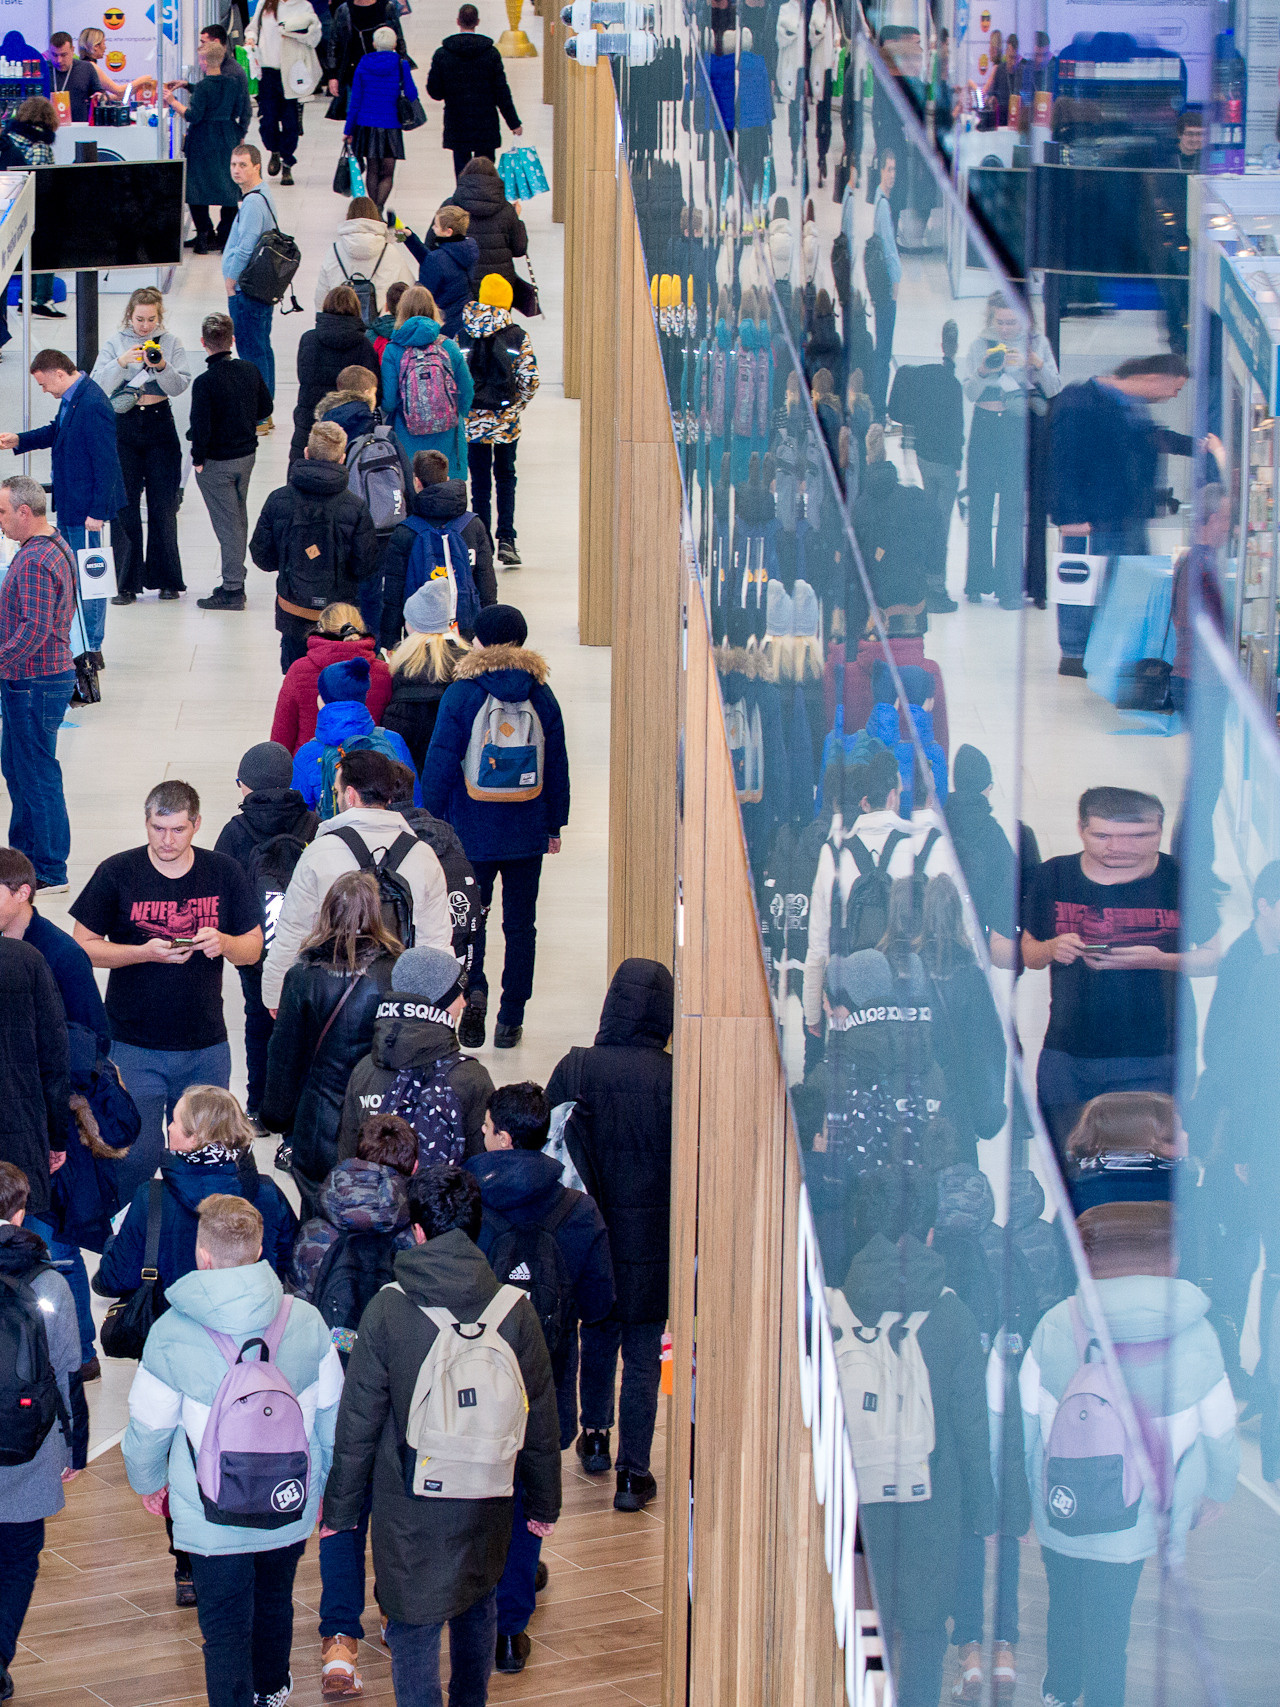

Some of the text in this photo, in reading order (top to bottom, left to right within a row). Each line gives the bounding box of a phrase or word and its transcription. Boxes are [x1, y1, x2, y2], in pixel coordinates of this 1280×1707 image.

[129, 896, 220, 922] NEVER GIVE
[359, 1094, 386, 1109] WO
